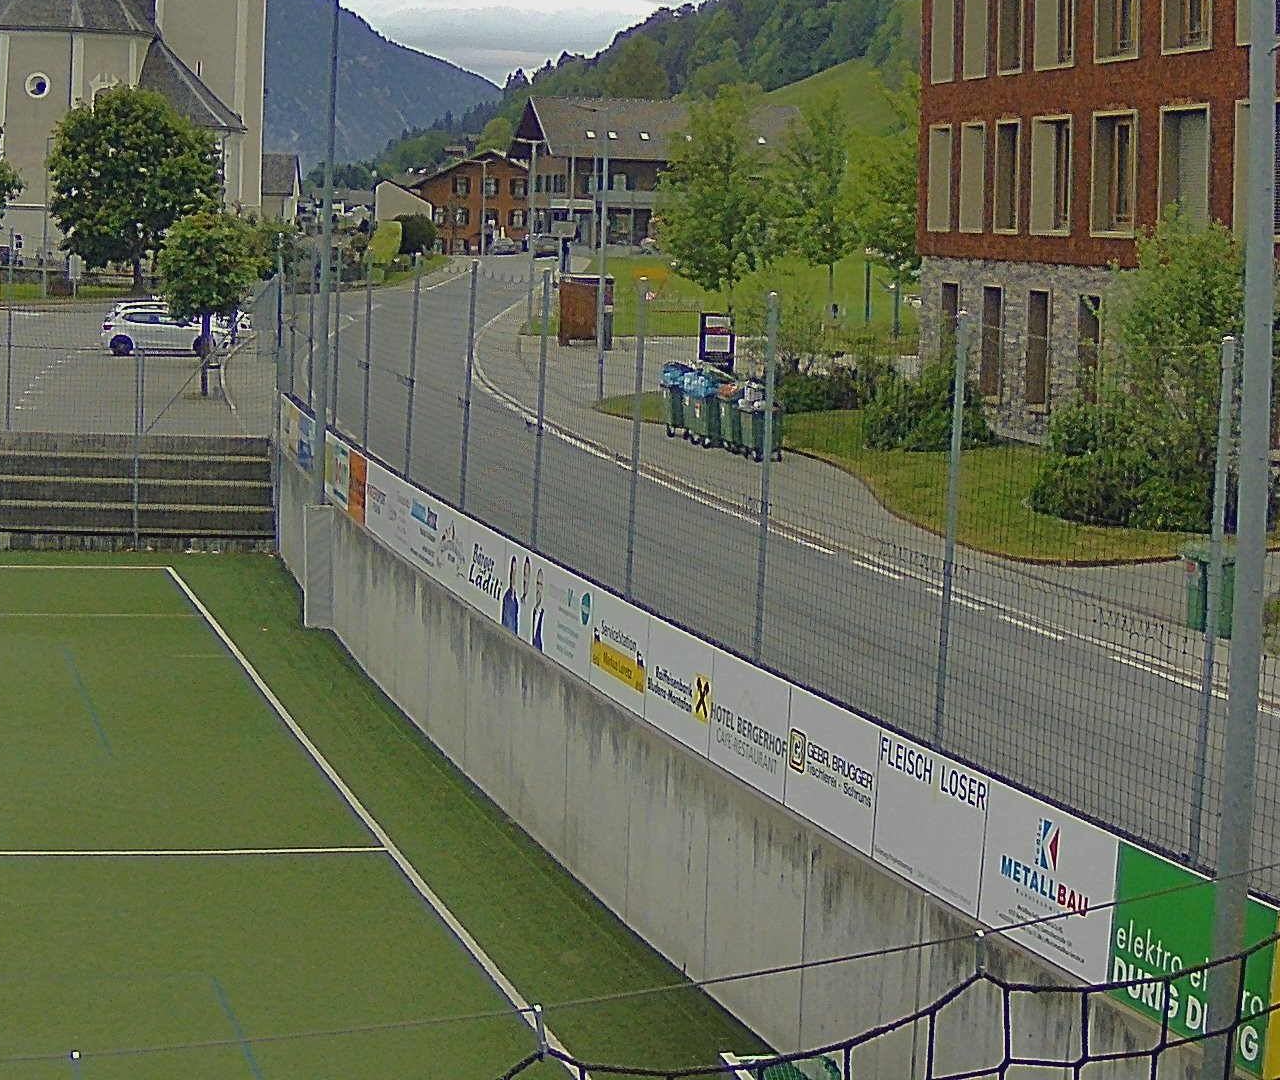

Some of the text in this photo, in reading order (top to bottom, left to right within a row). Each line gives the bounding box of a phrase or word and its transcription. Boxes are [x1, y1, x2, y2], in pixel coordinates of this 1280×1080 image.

[710, 701, 788, 758] HOTEL BERGERHOF
[880, 736, 987, 811] FLEISCH LOSER
[1116, 919, 1183, 976] elektro
[1189, 956, 1265, 1018] elro
